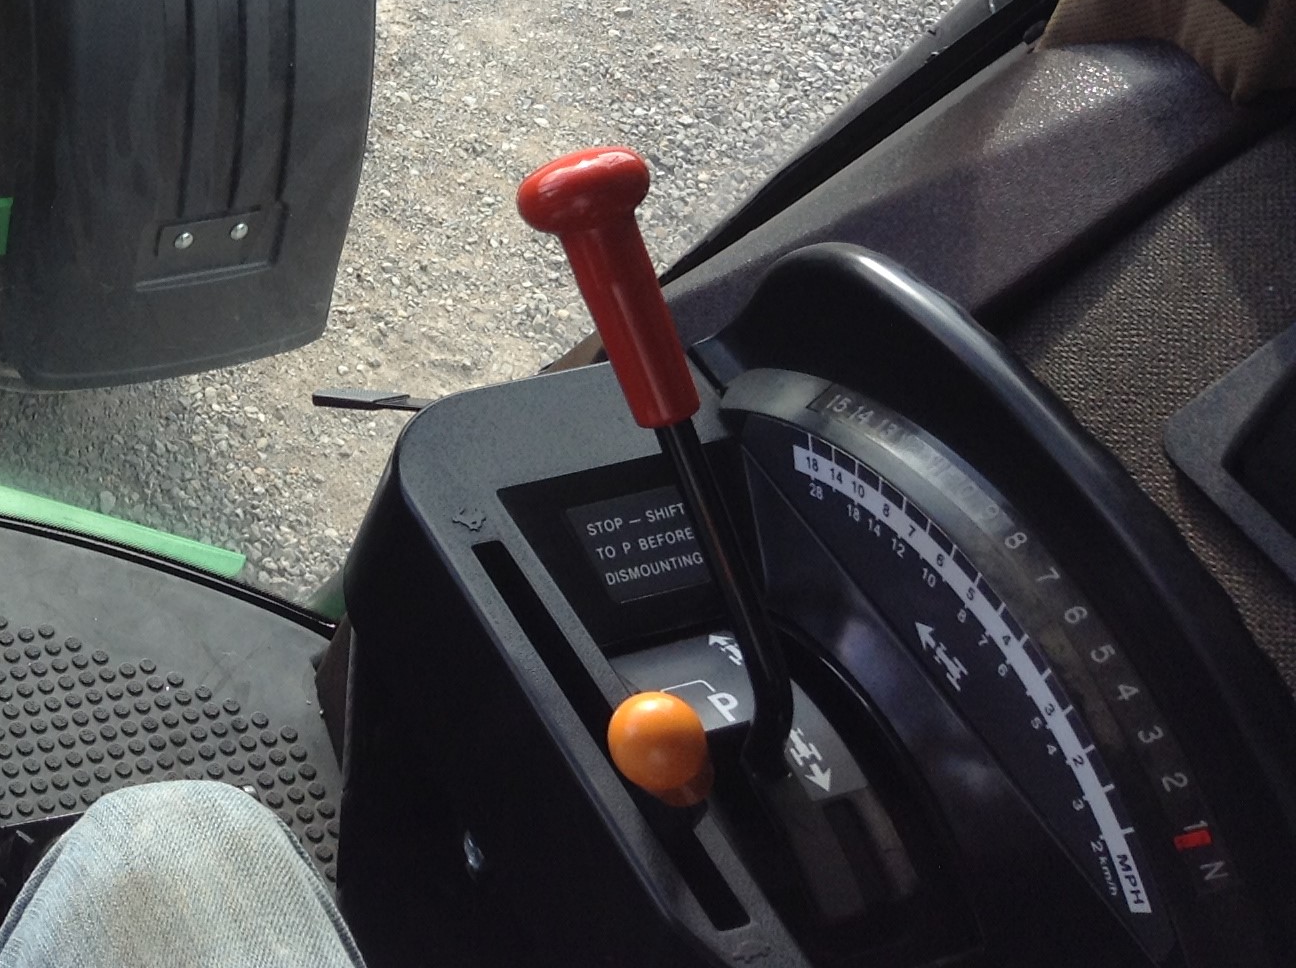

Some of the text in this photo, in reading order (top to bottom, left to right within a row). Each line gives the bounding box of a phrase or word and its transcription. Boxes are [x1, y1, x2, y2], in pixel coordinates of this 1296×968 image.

[586, 516, 623, 537] STOP
[644, 502, 686, 523] SHIFT
[595, 527, 695, 560] TO P BEFORE
[605, 551, 704, 586] DISMOUNTING
[826, 394, 852, 413] 15
[1004, 532, 1028, 549] 8
[1035, 566, 1060, 582] 7
[1064, 606, 1088, 624] 6
[1090, 644, 1116, 663] 5
[1116, 683, 1140, 701] 4
[1137, 725, 1164, 744] 3
[1161, 772, 1189, 792] 2
[1183, 820, 1208, 832] 1
[1199, 860, 1229, 881] N
[806, 456, 819, 472] 18
[830, 468, 843, 484] 14
[852, 480, 865, 498] 10
[882, 503, 890, 517] 8
[908, 525, 916, 536] 7
[936, 553, 944, 567] 6
[966, 587, 975, 601] 5
[1044, 703, 1055, 716] 3
[1072, 755, 1084, 767] 2
[1116, 854, 1144, 905] MPH
[808, 482, 824, 501] 28
[868, 518, 881, 537] 14
[891, 537, 905, 559] 12
[922, 567, 936, 588] 10
[977, 634, 989, 646] 7
[1090, 840, 1104, 853] 2
[706, 692, 739, 722] P
